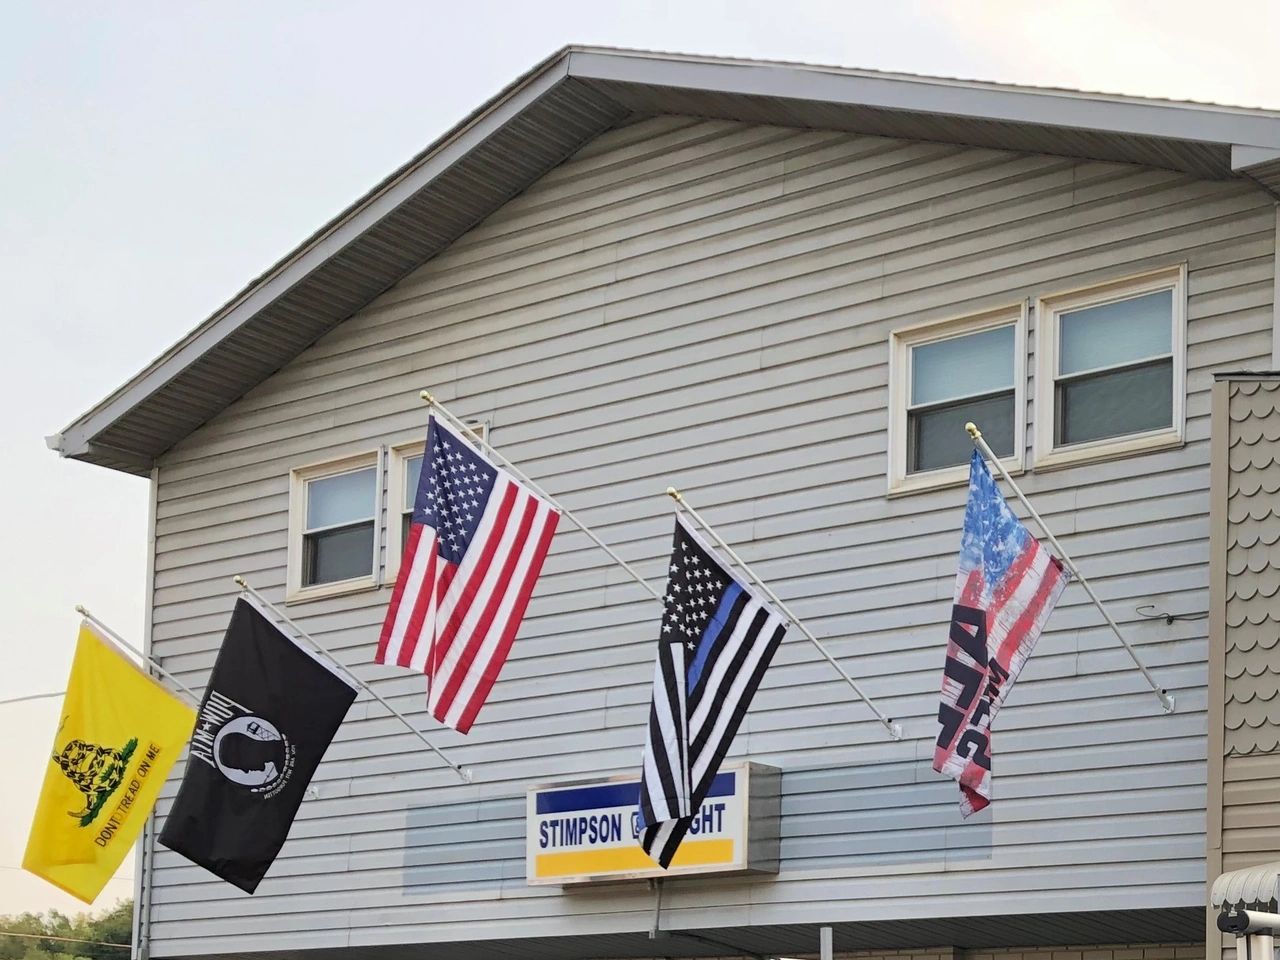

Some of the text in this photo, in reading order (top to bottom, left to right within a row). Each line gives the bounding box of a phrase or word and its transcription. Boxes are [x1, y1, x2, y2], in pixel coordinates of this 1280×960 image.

[117, 780, 140, 813] TREAD
[137, 760, 151, 778] ON
[145, 743, 160, 762] ME
[539, 813, 622, 848] STIMPSON
